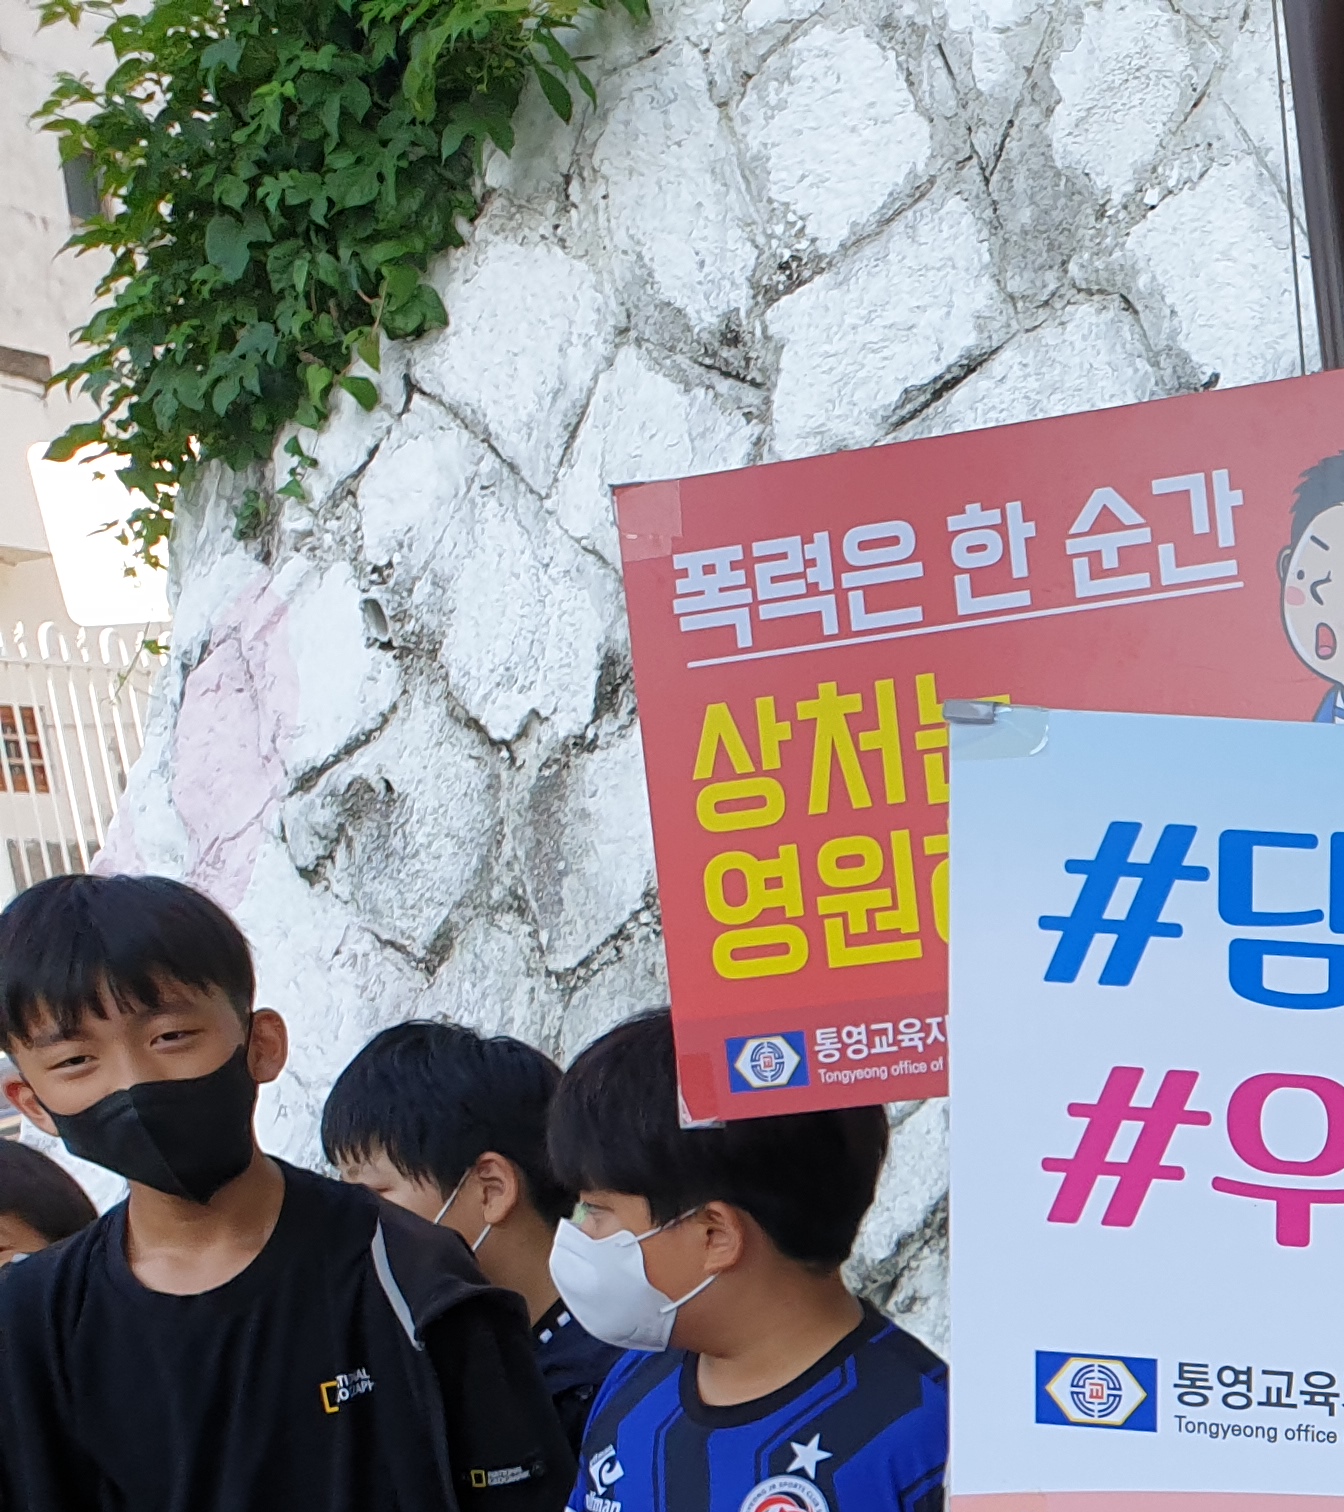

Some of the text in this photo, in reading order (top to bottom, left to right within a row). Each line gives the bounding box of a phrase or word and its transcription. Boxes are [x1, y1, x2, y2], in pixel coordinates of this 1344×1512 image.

[672, 468, 1244, 648] 폭력은 한 순간
[702, 829, 949, 980] 영원
[818, 1056, 944, 1084] Tongyeong office of
[1174, 1415, 1278, 1443] Tongyeong
[1283, 1422, 1337, 1445] office
